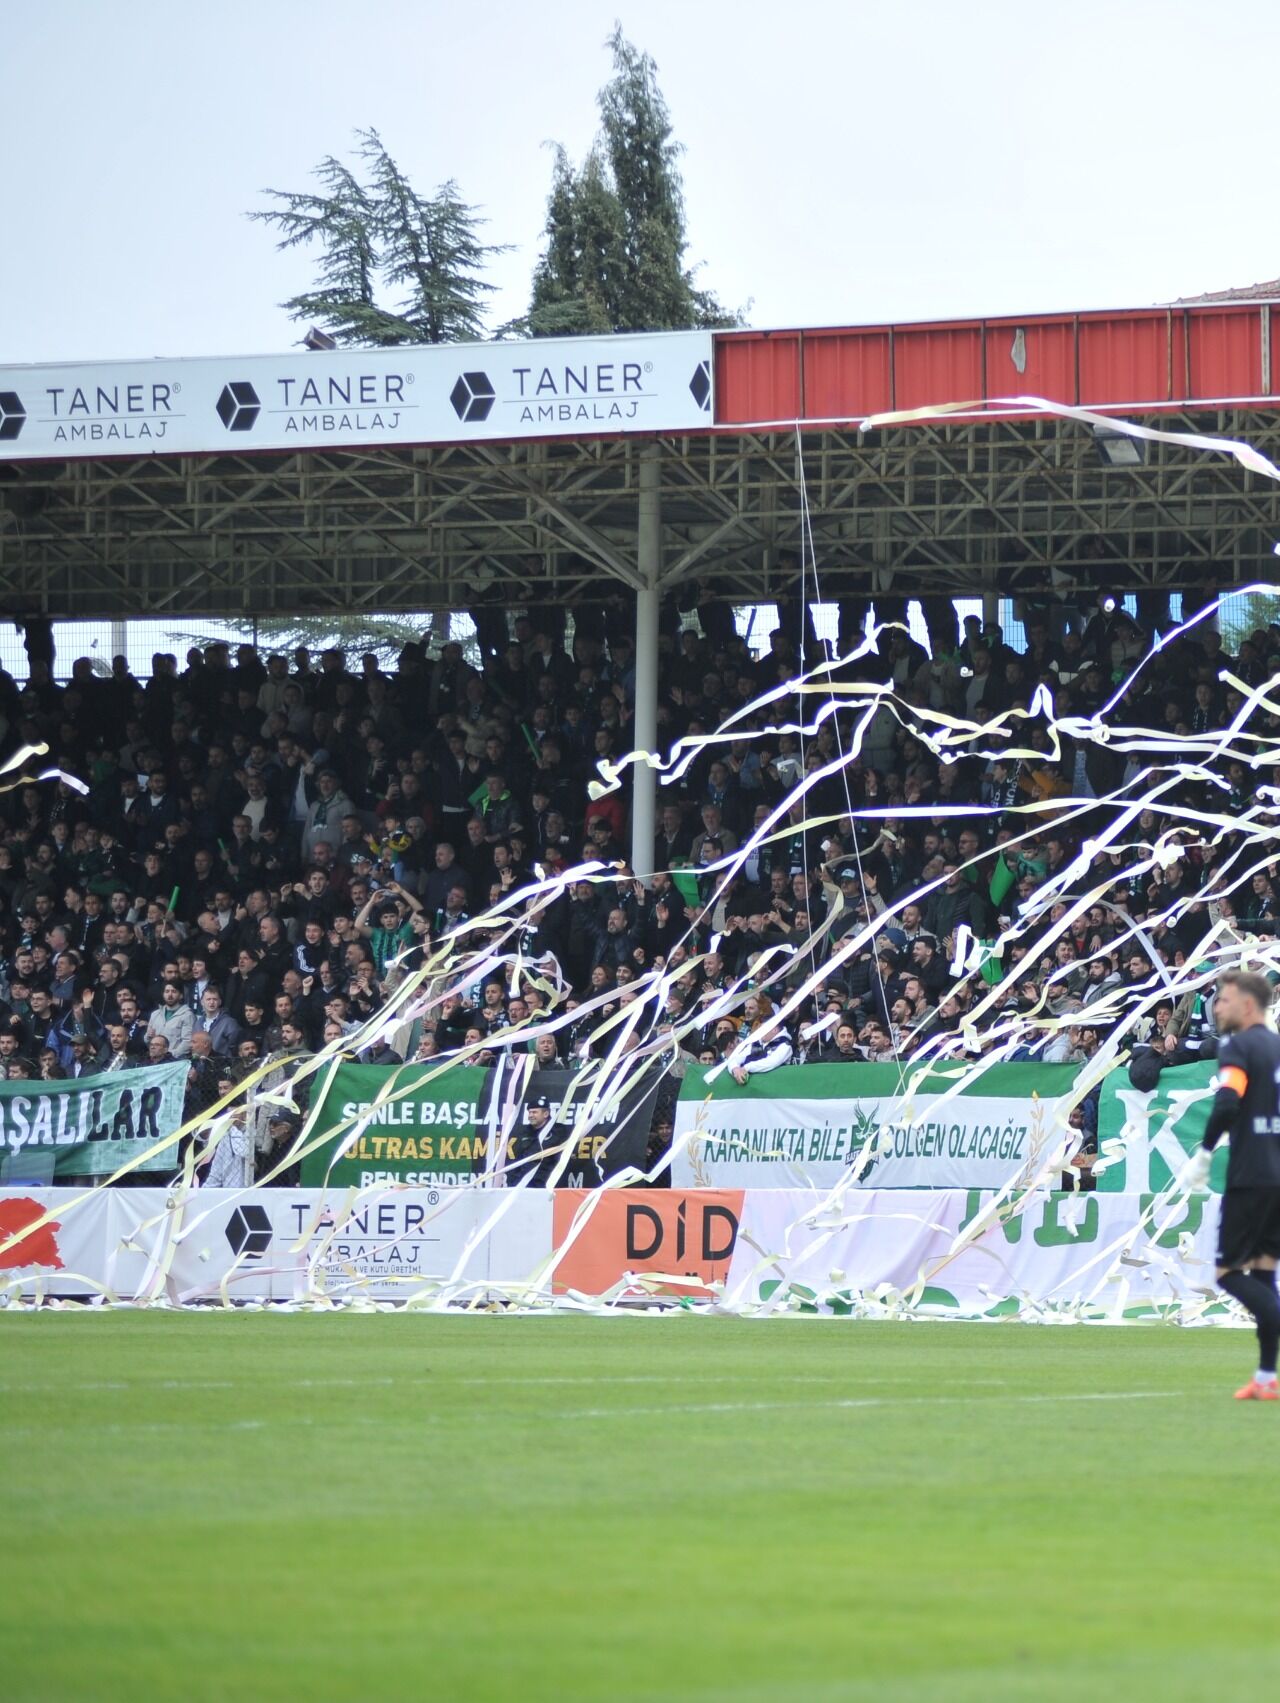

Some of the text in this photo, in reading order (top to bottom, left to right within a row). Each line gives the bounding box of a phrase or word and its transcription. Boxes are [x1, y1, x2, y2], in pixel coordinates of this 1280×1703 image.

[285, 412, 401, 433] AMBALAJ
[519, 401, 639, 423] AMBALAJ
[54, 421, 169, 442] AMBALAJ
[0, 1086, 163, 1157] ŞALILAR
[343, 1137, 434, 1160] ULTRAS
[704, 1128, 804, 1163] KARANLIKTA
[808, 1120, 847, 1162] BİLE
[949, 1117, 1028, 1160] OLACAĞIZ
